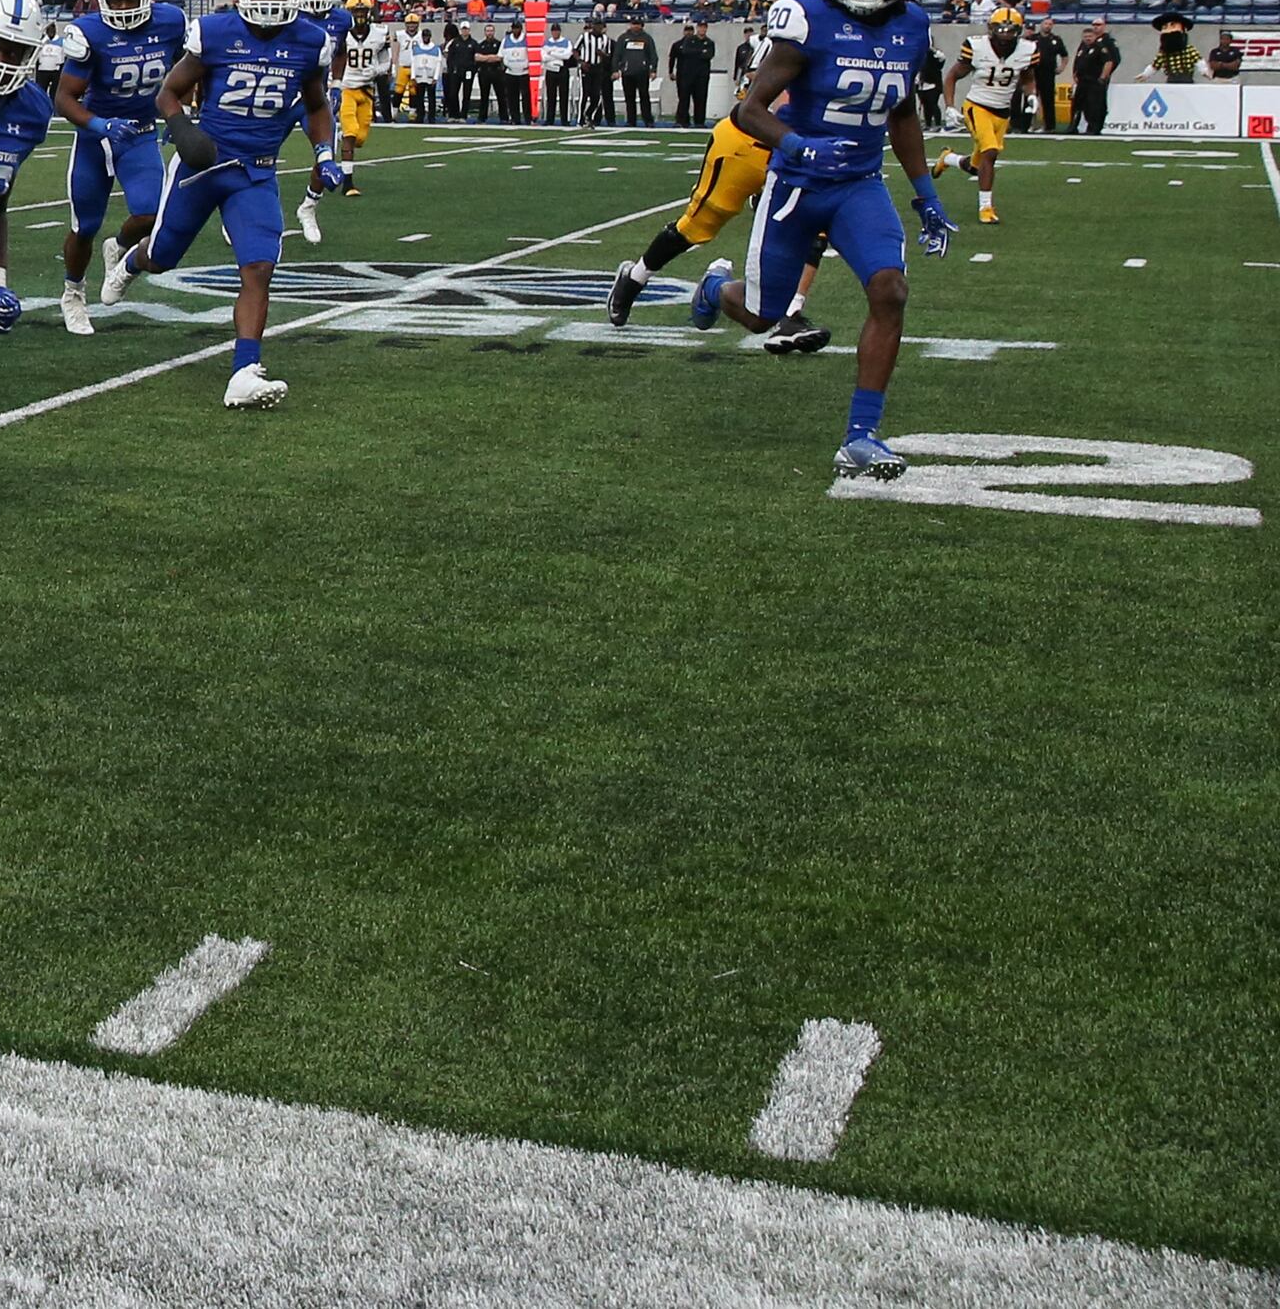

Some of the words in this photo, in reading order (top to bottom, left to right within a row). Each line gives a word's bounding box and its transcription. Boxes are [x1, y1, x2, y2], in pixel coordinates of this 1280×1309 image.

[769, 8, 792, 31] 20
[348, 48, 373, 68] 88
[836, 56, 884, 71] GEORGIA
[268, 66, 295, 78] STATE
[985, 65, 1014, 87] 13
[218, 70, 287, 118] 26
[822, 68, 907, 127] 20
[1102, 121, 1139, 133] eorgia
[1143, 120, 1190, 131] Natural
[1192, 121, 1216, 132] Gas
[1251, 117, 1273, 134] 20
